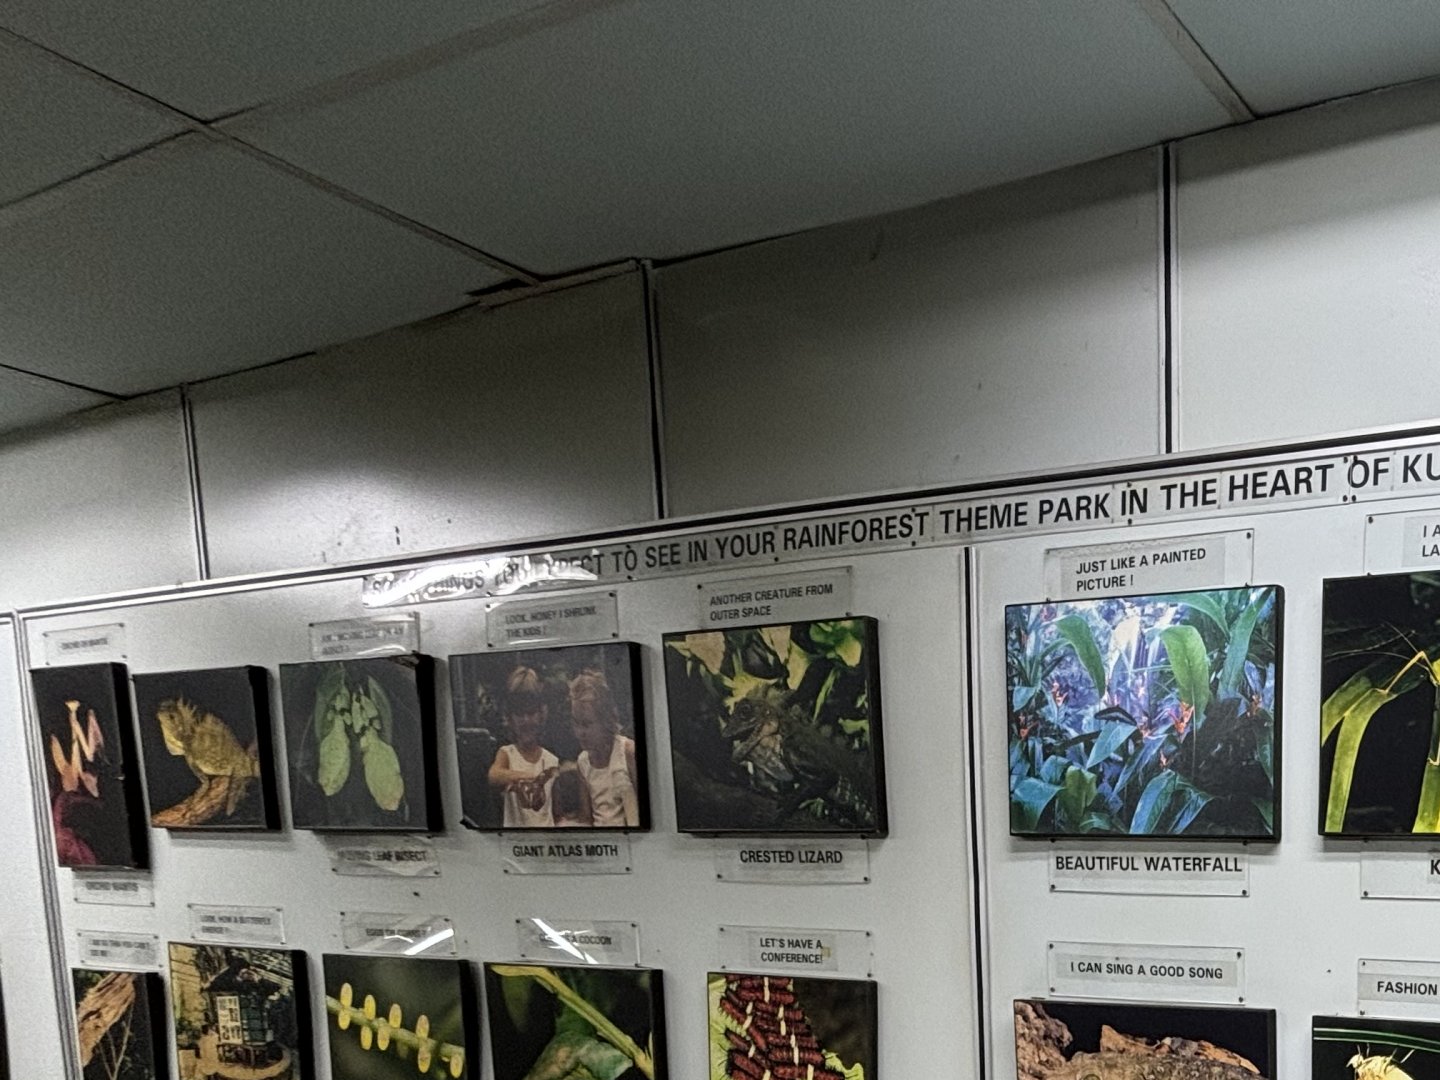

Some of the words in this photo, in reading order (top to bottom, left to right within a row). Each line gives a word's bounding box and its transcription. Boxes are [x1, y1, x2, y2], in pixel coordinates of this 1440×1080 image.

[614, 549, 638, 573] TO
[645, 542, 681, 568] SEE
[689, 539, 708, 563] IN
[715, 531, 776, 560] YOUR
[783, 512, 930, 551] RAINFOREST
[939, 502, 1028, 534] THEME
[1038, 492, 1111, 525] PARK
[1121, 487, 1149, 516] IN
[1159, 478, 1218, 511] THE
[1228, 464, 1335, 502] HEART
[1347, 456, 1390, 489] OF
[1076, 559, 1107, 575] JUST
[1111, 556, 1135, 570] LIKE
[1139, 553, 1148, 567] A
[1152, 548, 1206, 566] PAINTED
[1076, 575, 1126, 592] PICTURE
[710, 592, 752, 606] ANOTHER
[755, 586, 802, 602] CREATURE
[806, 583, 833, 597] FROM
[710, 608, 739, 621] OUTER
[741, 605, 771, 618] SPACE
[512, 844, 545, 858] GIANT
[548, 844, 583, 858] ATLAS
[585, 844, 618, 858] MOTH
[740, 850, 794, 864] CRESTED
[798, 850, 843, 864] LIZARD
[1055, 855, 1139, 872] BEAUTIFUL
[1144, 856, 1243, 873] WATERFALL
[760, 937, 785, 948] LET'S
[788, 938, 813, 949] HAVE
[815, 939, 822, 949] A
[1077, 962, 1102, 975] CAN
[1105, 963, 1134, 976] SING
[1138, 964, 1146, 976] A
[1150, 965, 1185, 979] GOOD
[1188, 966, 1223, 980] SONG
[1376, 981, 1438, 996] FASHION
